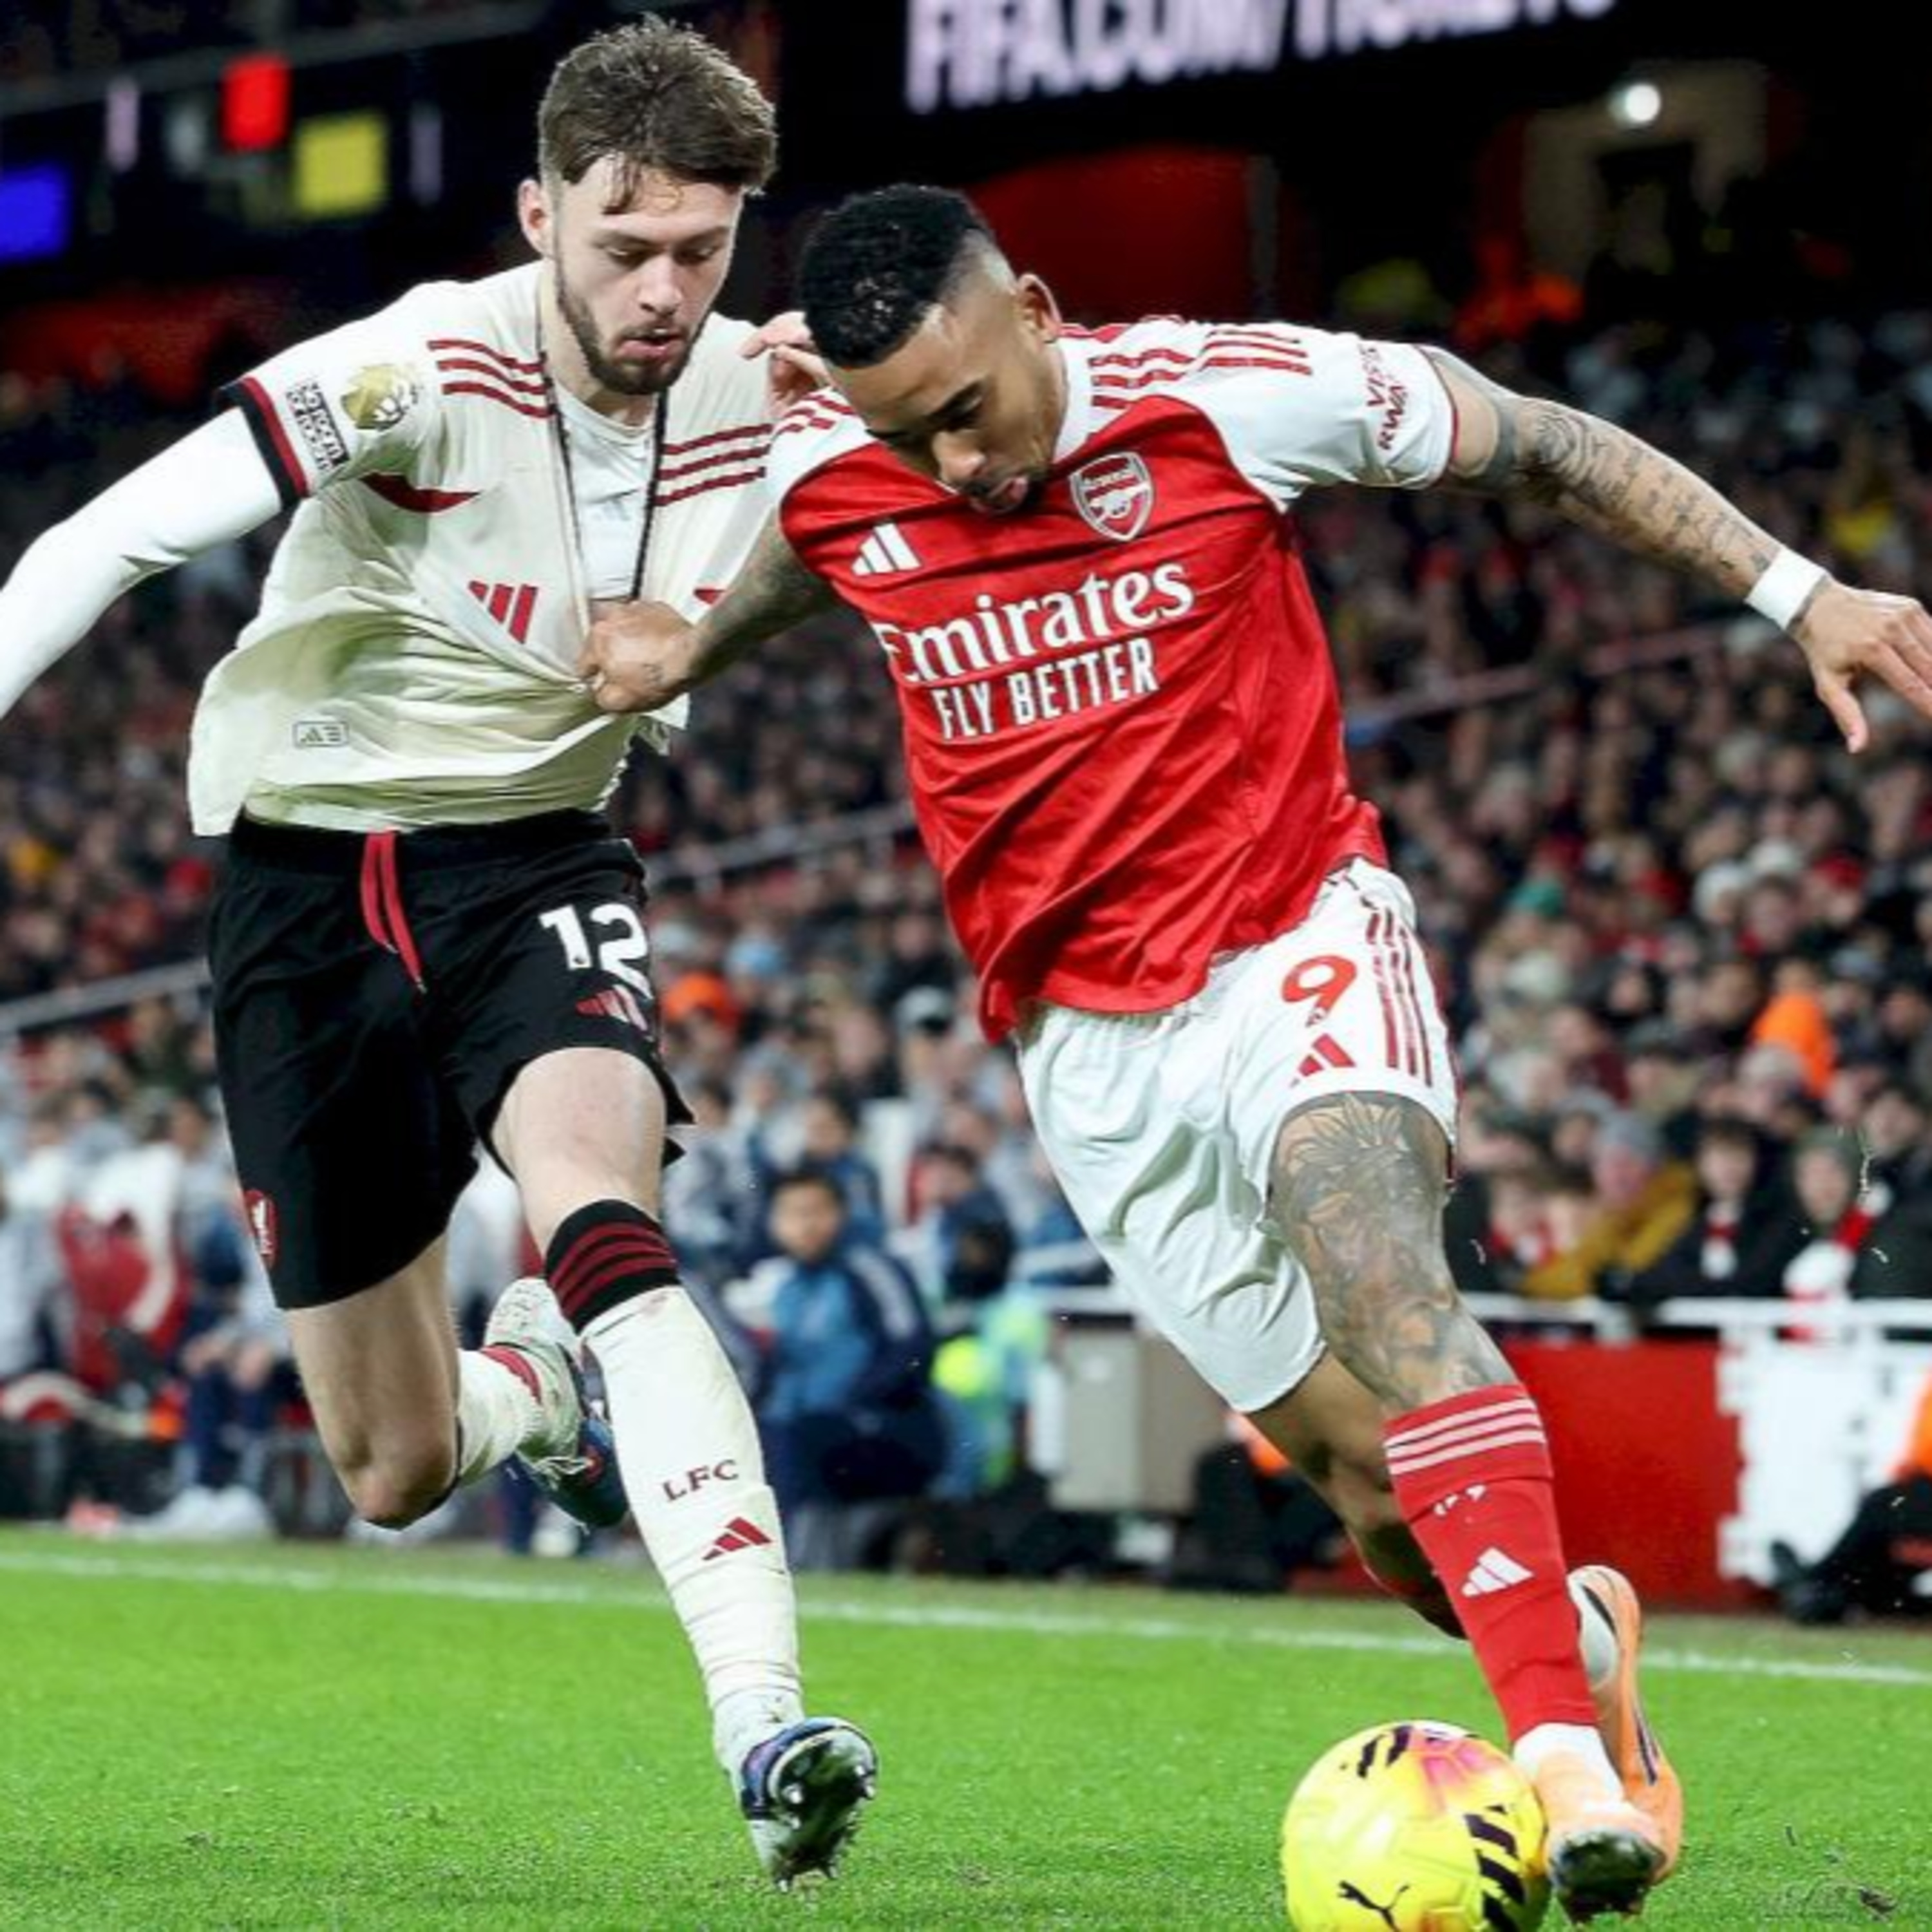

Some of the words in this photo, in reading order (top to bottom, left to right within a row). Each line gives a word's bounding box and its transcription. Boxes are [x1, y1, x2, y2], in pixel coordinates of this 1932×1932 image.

[932, 680, 994, 740] FLY
[1007, 637, 1159, 726] BETTER
[539, 903, 653, 999] 12
[1282, 956, 1357, 1027] 9
[663, 1459, 739, 1502] LFC
